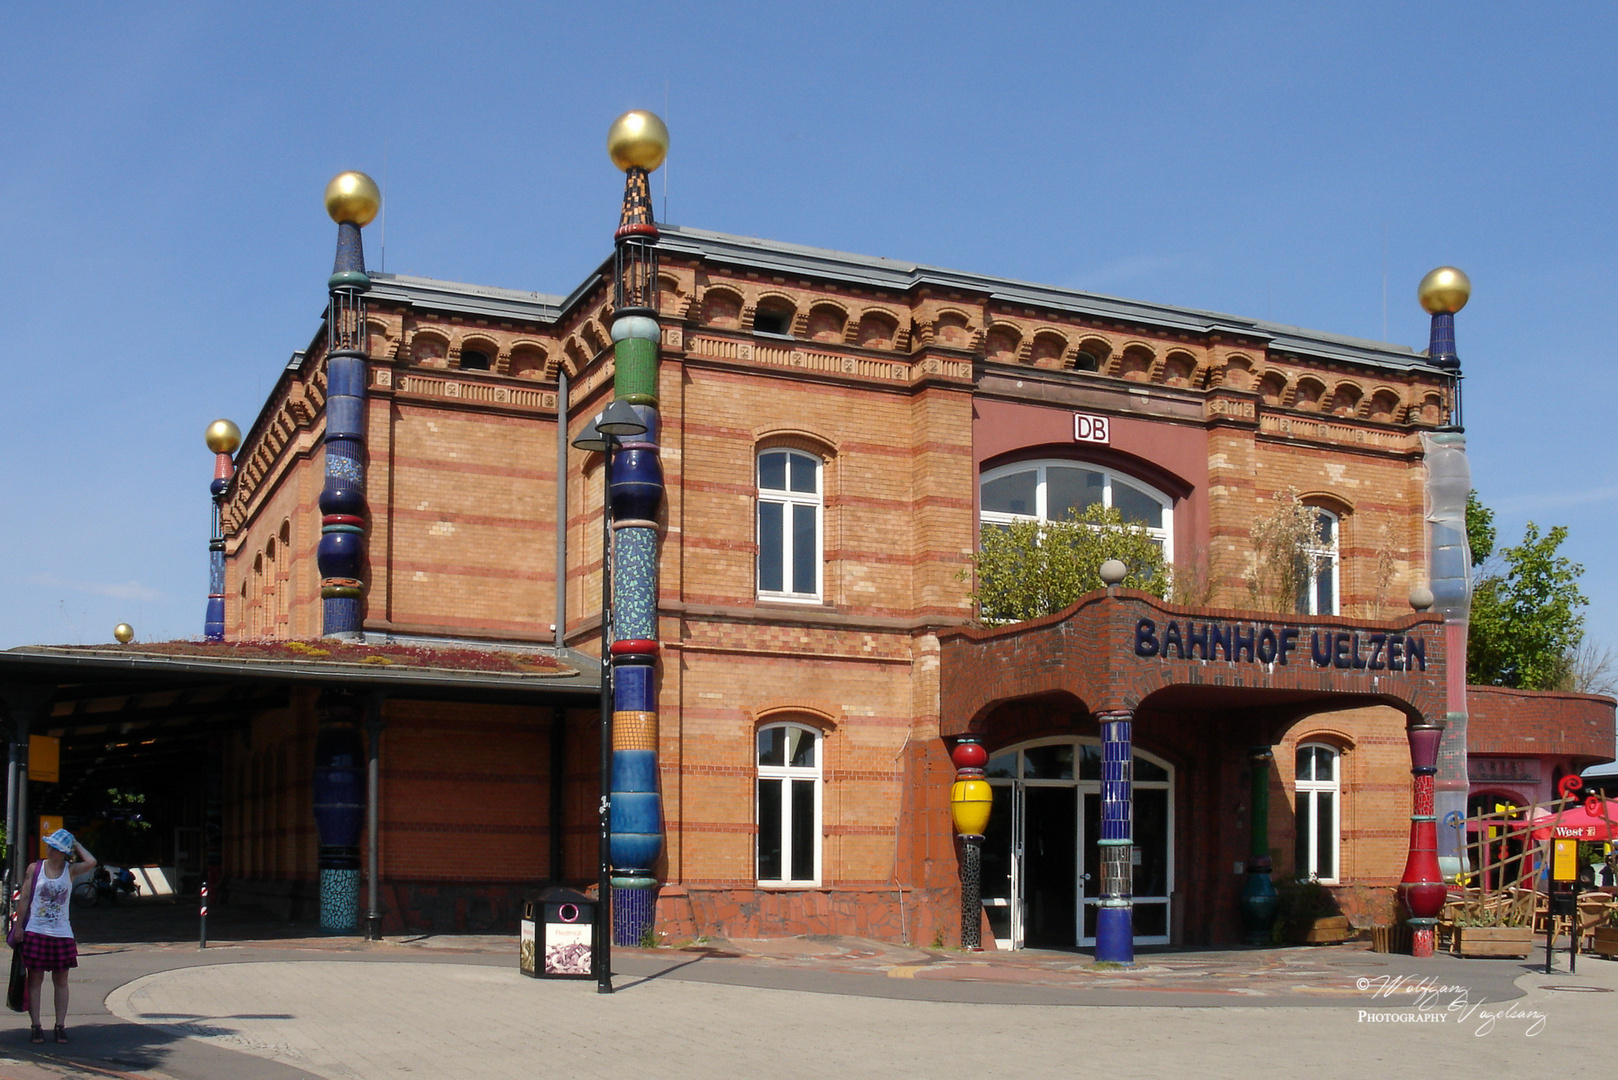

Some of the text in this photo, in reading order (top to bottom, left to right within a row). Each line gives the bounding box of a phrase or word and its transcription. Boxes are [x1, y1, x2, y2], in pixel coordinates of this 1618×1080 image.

[1078, 416, 1106, 440] DB
[1134, 617, 1426, 672] BAHNHOF UELZEN
[1556, 826, 1584, 837] West
